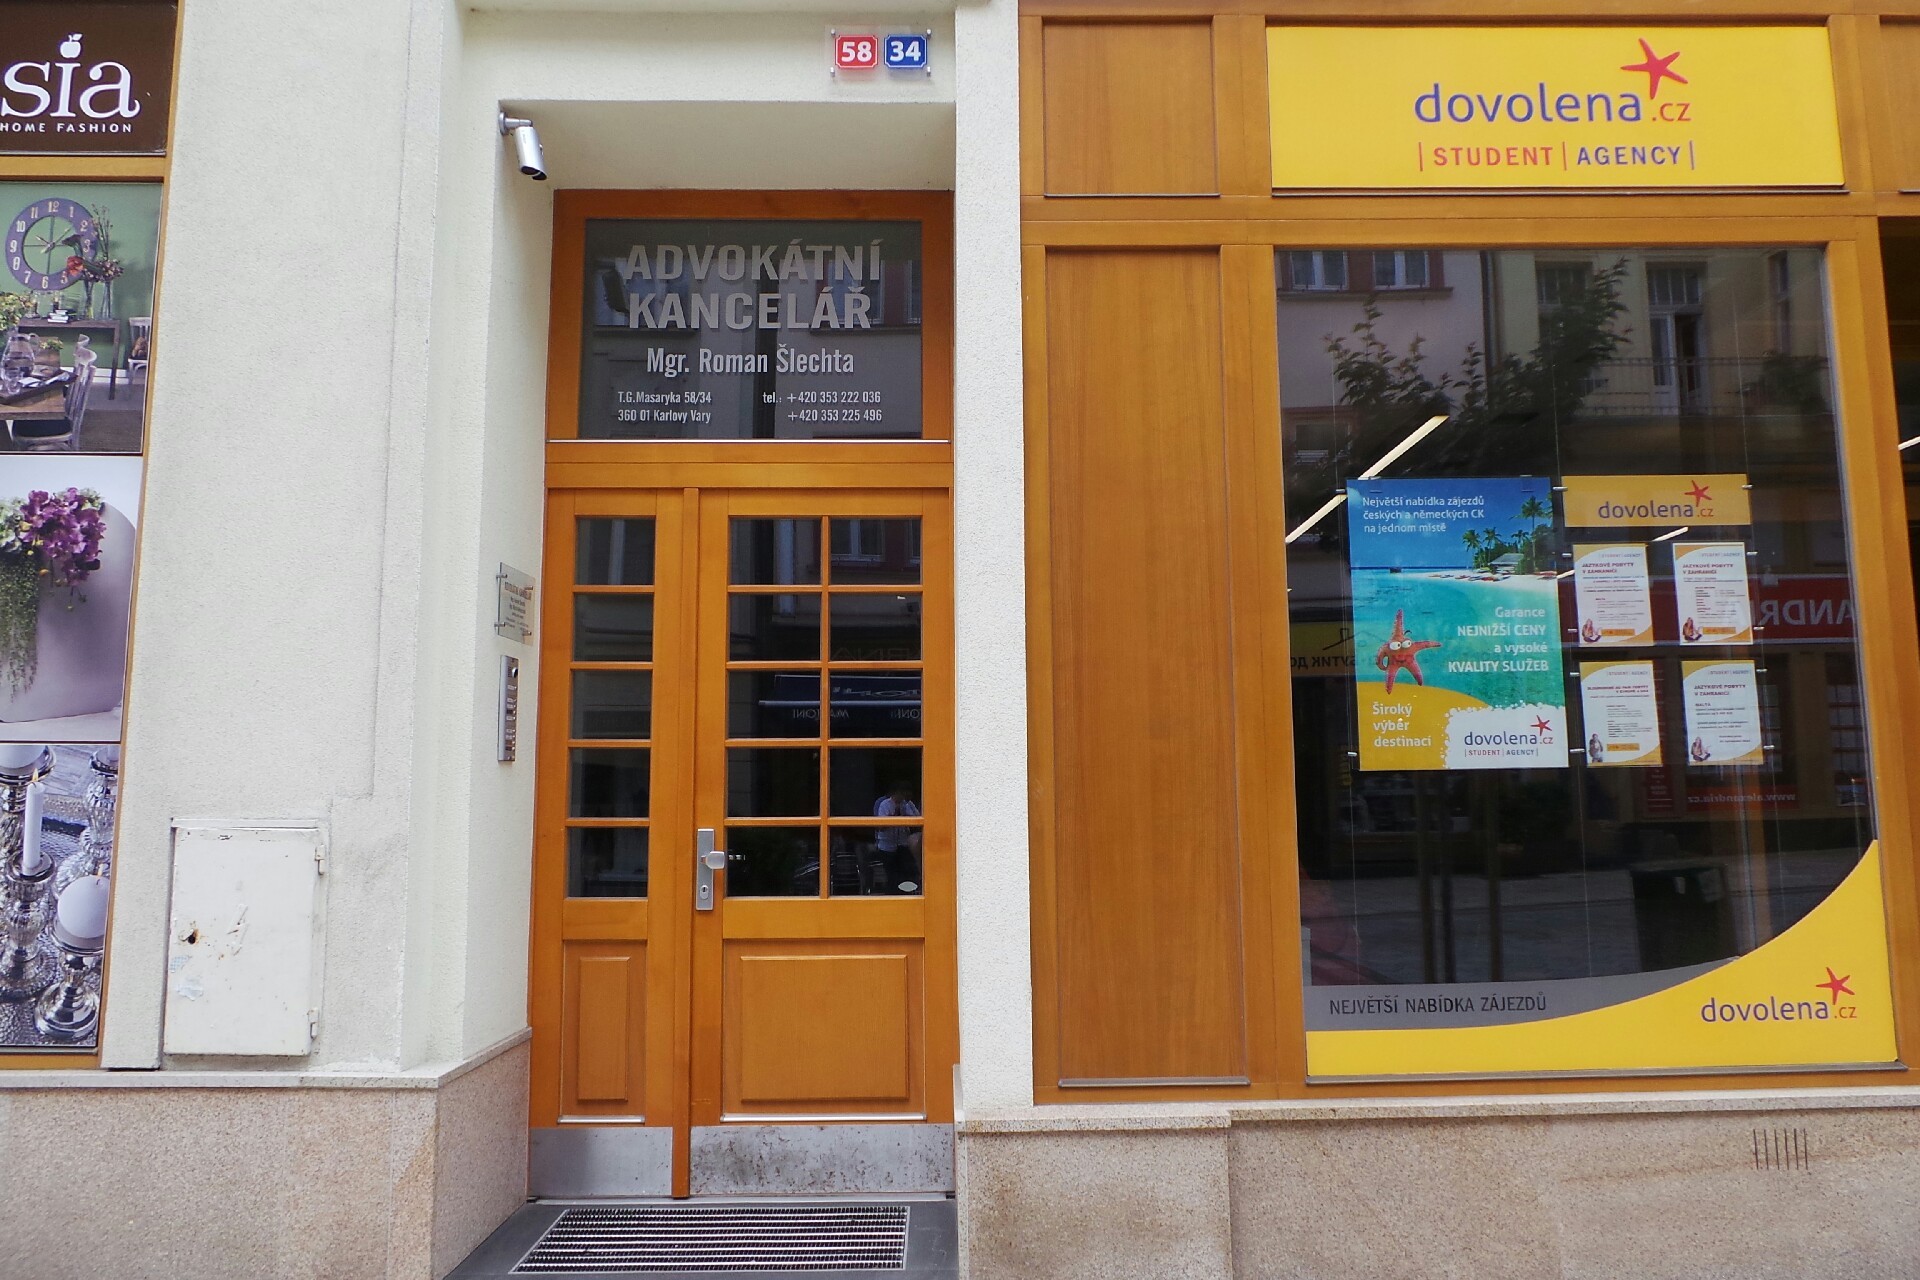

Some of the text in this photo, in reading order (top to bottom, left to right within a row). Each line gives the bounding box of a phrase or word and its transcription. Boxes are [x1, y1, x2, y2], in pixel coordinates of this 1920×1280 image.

[841, 41, 873, 62] 58
[889, 41, 922, 62] 34
[0, 33, 141, 119] sia
[1414, 82, 1692, 123] dovolena.cz
[0, 122, 132, 133] HOME FASHION
[1432, 145, 1682, 167] STUDENT AGENCY
[30, 206, 39, 219] 11
[48, 201, 60, 213] 12
[69, 206, 75, 218] 1
[16, 220, 26, 233] 10
[80, 220, 88, 232] 2
[10, 240, 17, 253] 9
[83, 239, 91, 253] 3
[12, 256, 20, 271] 8
[623, 238, 884, 281] ADVOKÁTNÍ
[24, 270, 31, 284] 7
[42, 275, 49, 289] 6
[629, 286, 872, 330] KANCELÁŘ
[647, 343, 854, 377] Mgr. Roman Šlechta
[618, 390, 712, 406] T.G.Masaryka 58/34
[786, 391, 818, 404] +420
[819, 391, 839, 404] 353
[841, 391, 860, 404] 222
[862, 391, 881, 404] 036
[618, 408, 712, 424] 360 01 Karlovy Vary
[787, 410, 882, 423] +420 353 225 496
[1362, 495, 1485, 508] Největší nabídka zájezdů
[1363, 509, 1401, 521] českých
[1413, 509, 1469, 521] německých
[1471, 509, 1485, 519] CK
[1598, 499, 1715, 519] dovolena.cz
[1364, 522, 1447, 534] na jednom místě
[1495, 606, 1546, 617] Garance
[1457, 624, 1546, 637] NEJNIŽŠÍ CENY
[1494, 643, 1548, 656] a vysoké
[1448, 658, 1549, 673] KVALITY SLUŽEB
[1372, 701, 1412, 716] Široký
[1373, 719, 1409, 733] výběr
[1374, 735, 1432, 747] destinací
[1464, 731, 1554, 746] dovolena.cz
[1329, 991, 1547, 1015] NEJVĚTŠÍ NABÍDKA ZÁJEZDŮ
[1701, 996, 1858, 1023] dovolena.cz
